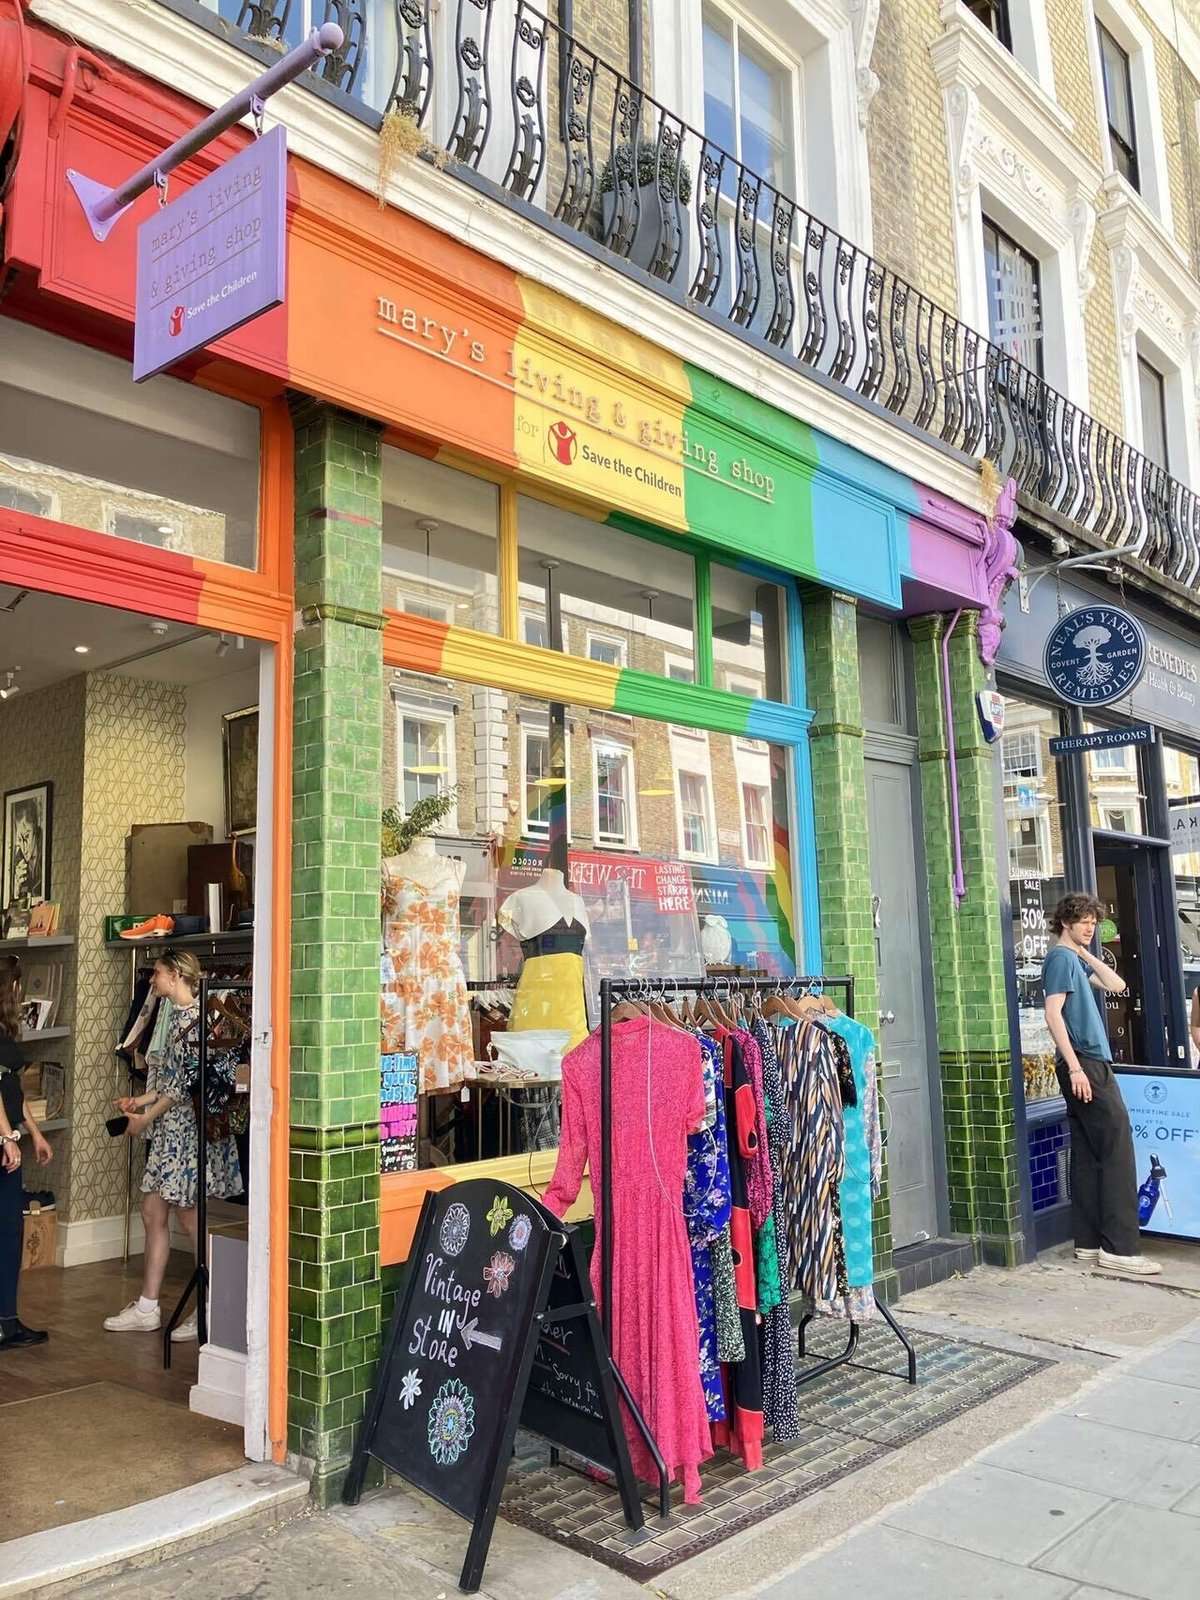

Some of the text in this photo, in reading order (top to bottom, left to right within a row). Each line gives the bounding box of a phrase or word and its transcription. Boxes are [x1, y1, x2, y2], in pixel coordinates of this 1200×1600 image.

[151, 166, 262, 252] mary's living
[151, 217, 261, 298] & giving shop
[187, 270, 257, 320] Save the Children
[377, 295, 485, 362] mary's
[505, 348, 601, 423] living
[613, 402, 627, 428] &
[639, 419, 719, 474] giving
[732, 458, 776, 498] shop
[517, 415, 682, 498] for Save the Children
[1051, 612, 1135, 656] NEAL'S YARD
[1051, 647, 1137, 669] COVENT GARDEN
[1055, 660, 1135, 699] REMEDIES
[1053, 730, 1147, 750] THERAPY ROOMS
[654, 864, 685, 874] LASTING
[656, 875, 686, 885] CHANGE
[1024, 880, 1040, 890] SALE
[659, 896, 690, 911] HERE
[1021, 908, 1047, 929] 30%
[424, 1253, 481, 1329] Vintage
[437, 1308, 456, 1338] IN
[552, 1363, 582, 1400] Sorry
